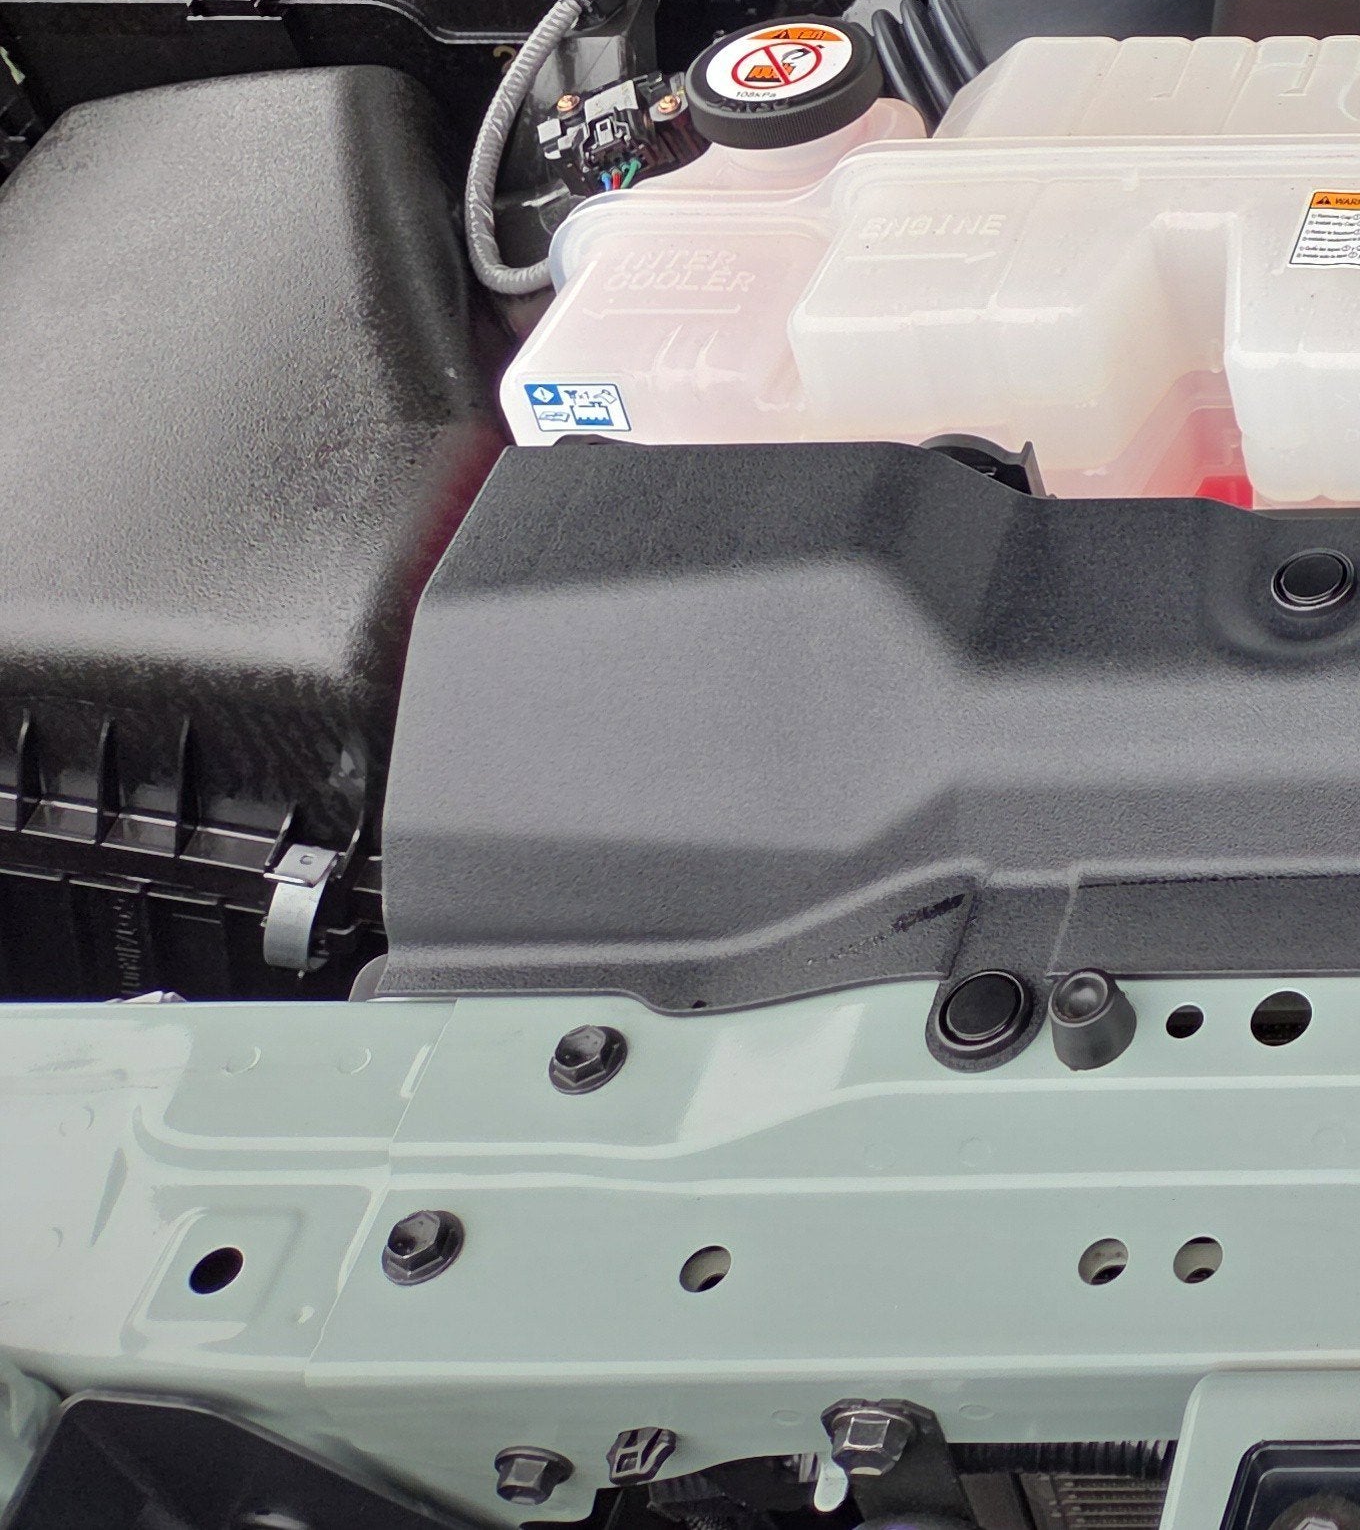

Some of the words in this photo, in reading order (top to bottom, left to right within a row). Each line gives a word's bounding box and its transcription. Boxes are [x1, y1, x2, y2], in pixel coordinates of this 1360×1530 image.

[860, 214, 1005, 238] ENGINE
[616, 249, 739, 272] INTER
[602, 270, 756, 293] COOLER
